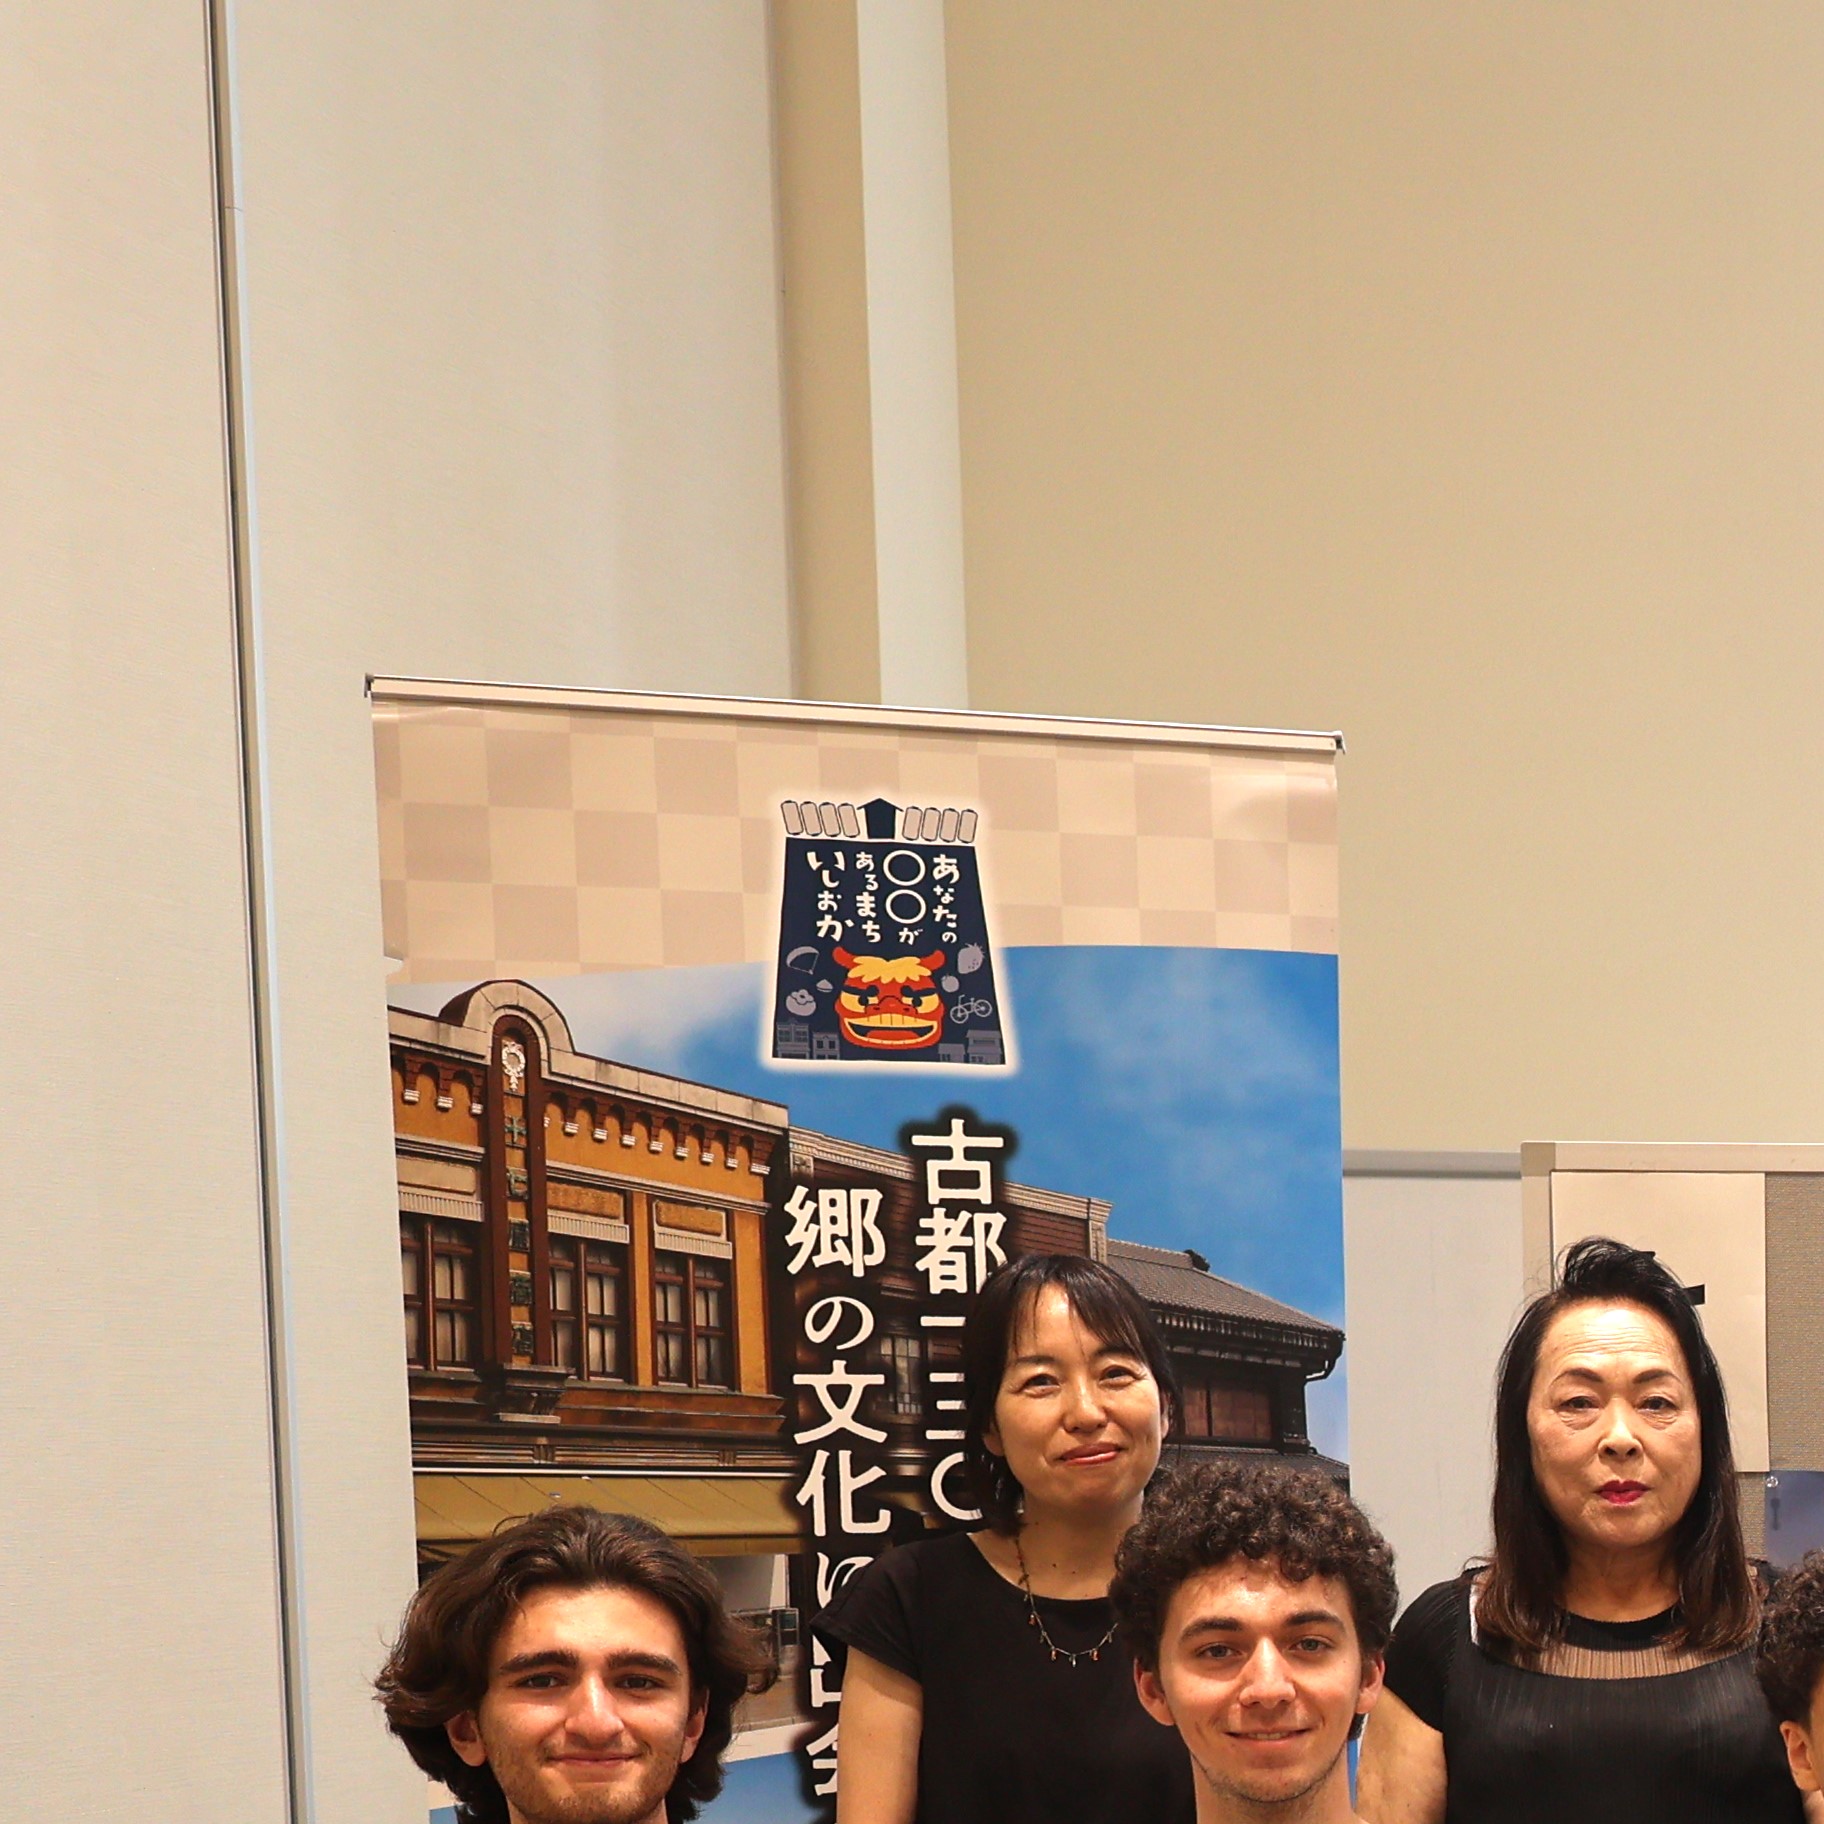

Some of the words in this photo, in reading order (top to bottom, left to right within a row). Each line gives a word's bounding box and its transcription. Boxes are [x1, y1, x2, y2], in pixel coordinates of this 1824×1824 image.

[807, 851, 854, 942] いしおか
[855, 851, 882, 943] あるまち
[932, 853, 960, 943] あなたの
